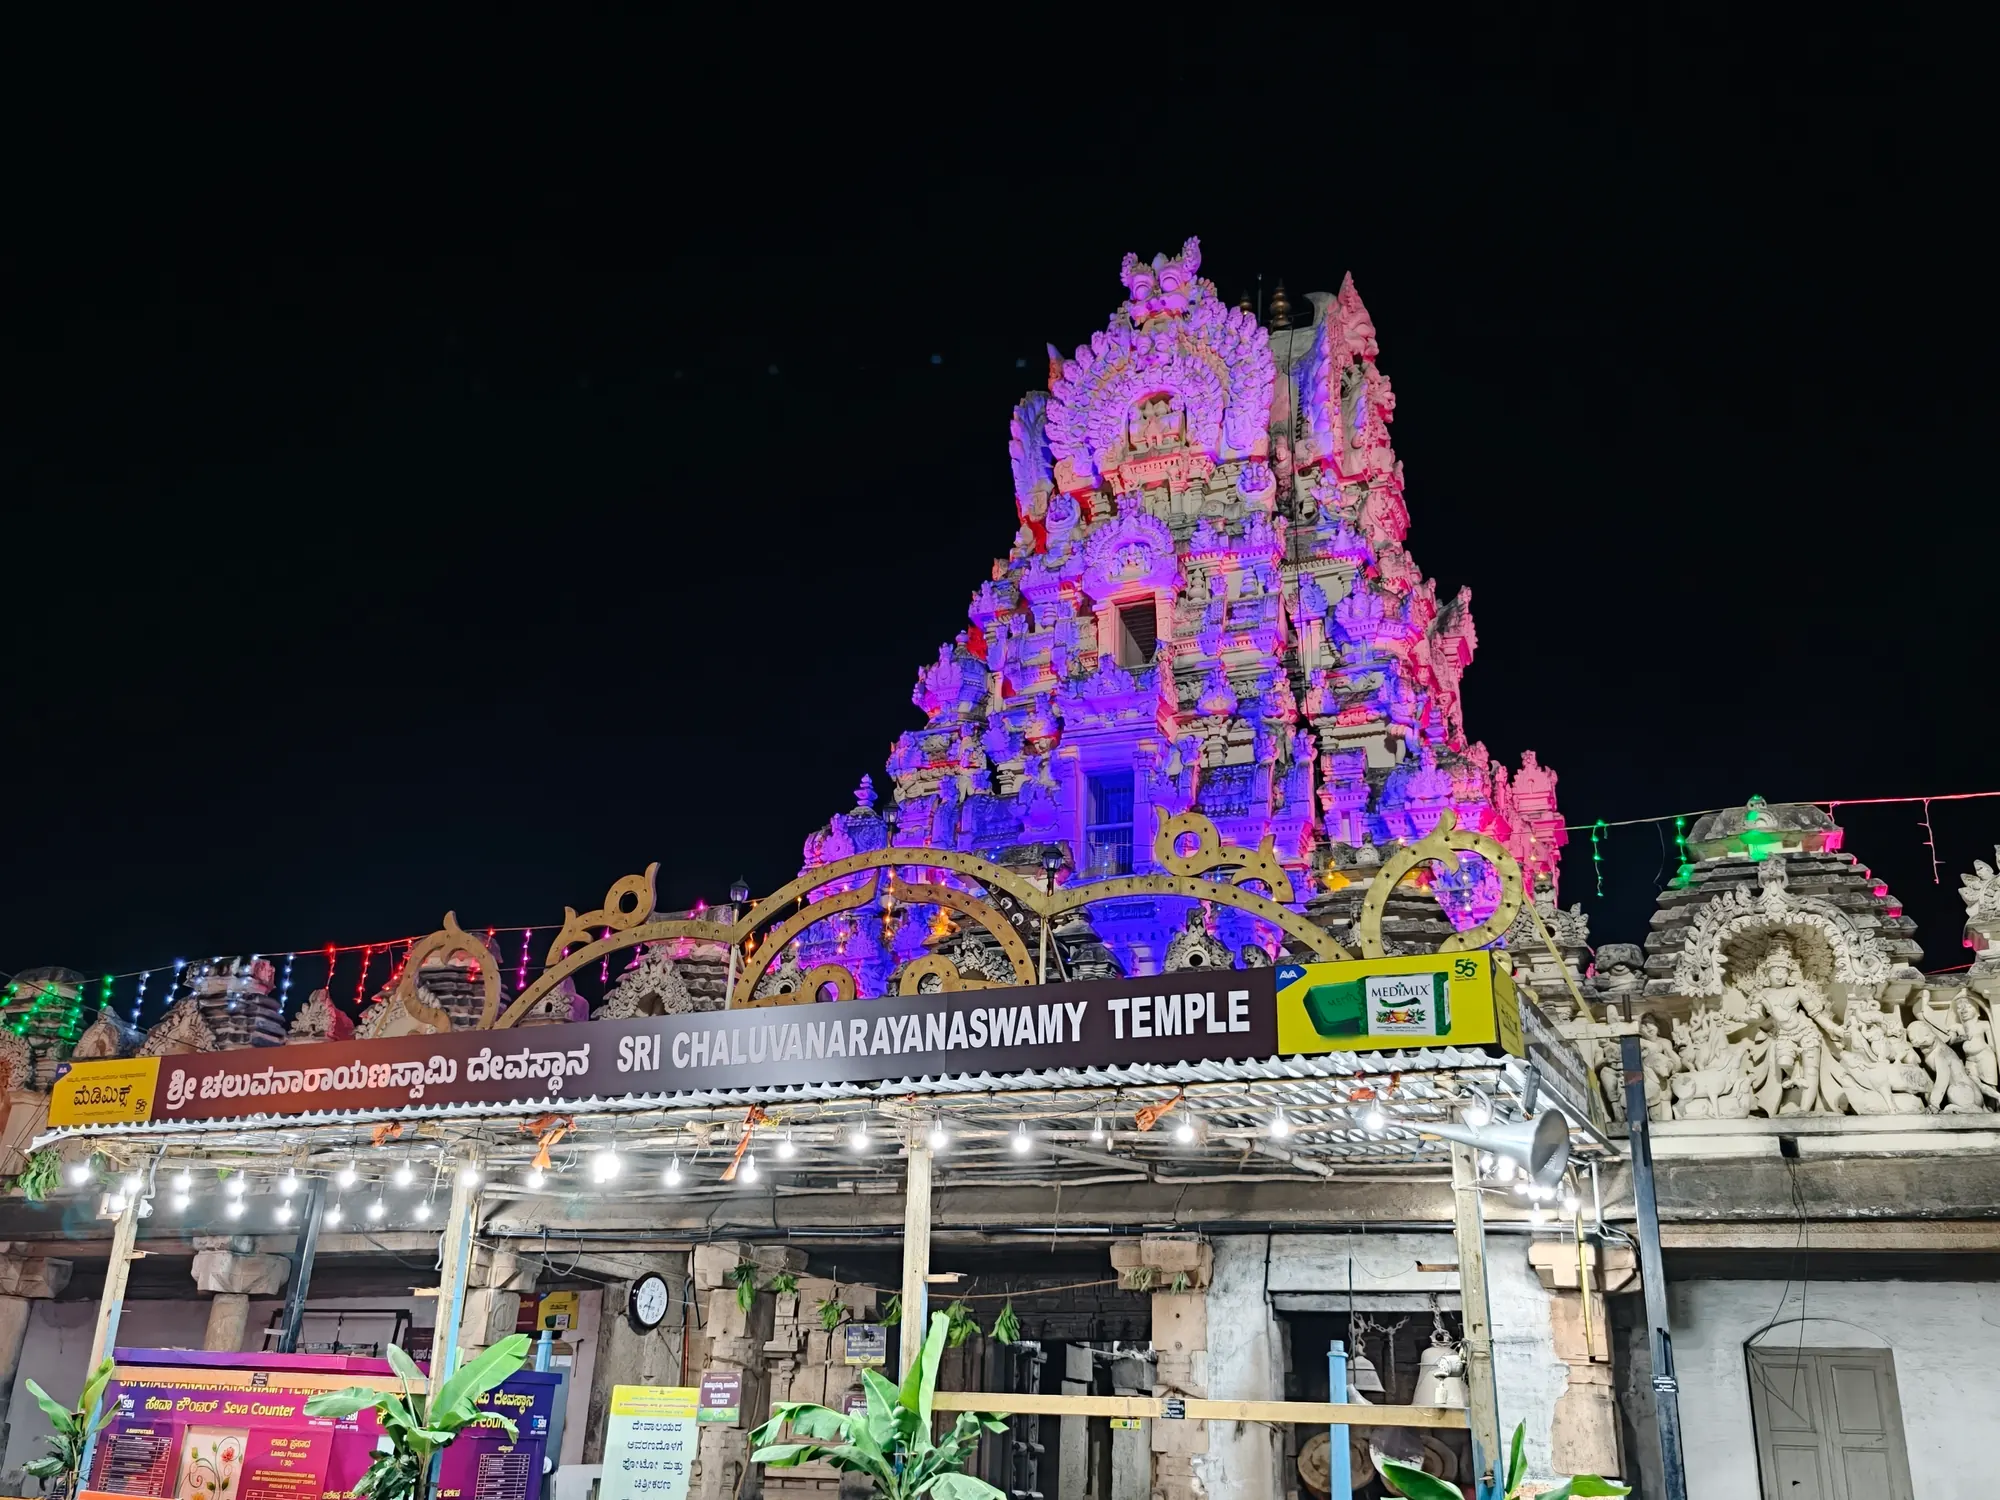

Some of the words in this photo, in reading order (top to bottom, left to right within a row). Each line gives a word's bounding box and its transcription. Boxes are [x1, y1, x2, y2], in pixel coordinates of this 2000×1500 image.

[1371, 983, 1430, 998] MEDIMIX
[617, 1034, 661, 1073] SRI
[671, 1001, 1088, 1070] CHALUVANARAYANASWAMY
[1107, 989, 1251, 1040] TEMPLE
[166, 1068, 198, 1110] ಶ್ರೀ
[199, 1055, 458, 1099] ಚಲುವನಾರಾಯಣಸ್ವಾಮಿ
[466, 1042, 591, 1096] ದೇವಸ್ಥಾನ
[122, 1399, 135, 1409] SBI
[223, 1401, 248, 1415] Seva
[251, 1402, 295, 1417] Counter
[632, 1420, 682, 1432] ದೇವಾಲಯದ
